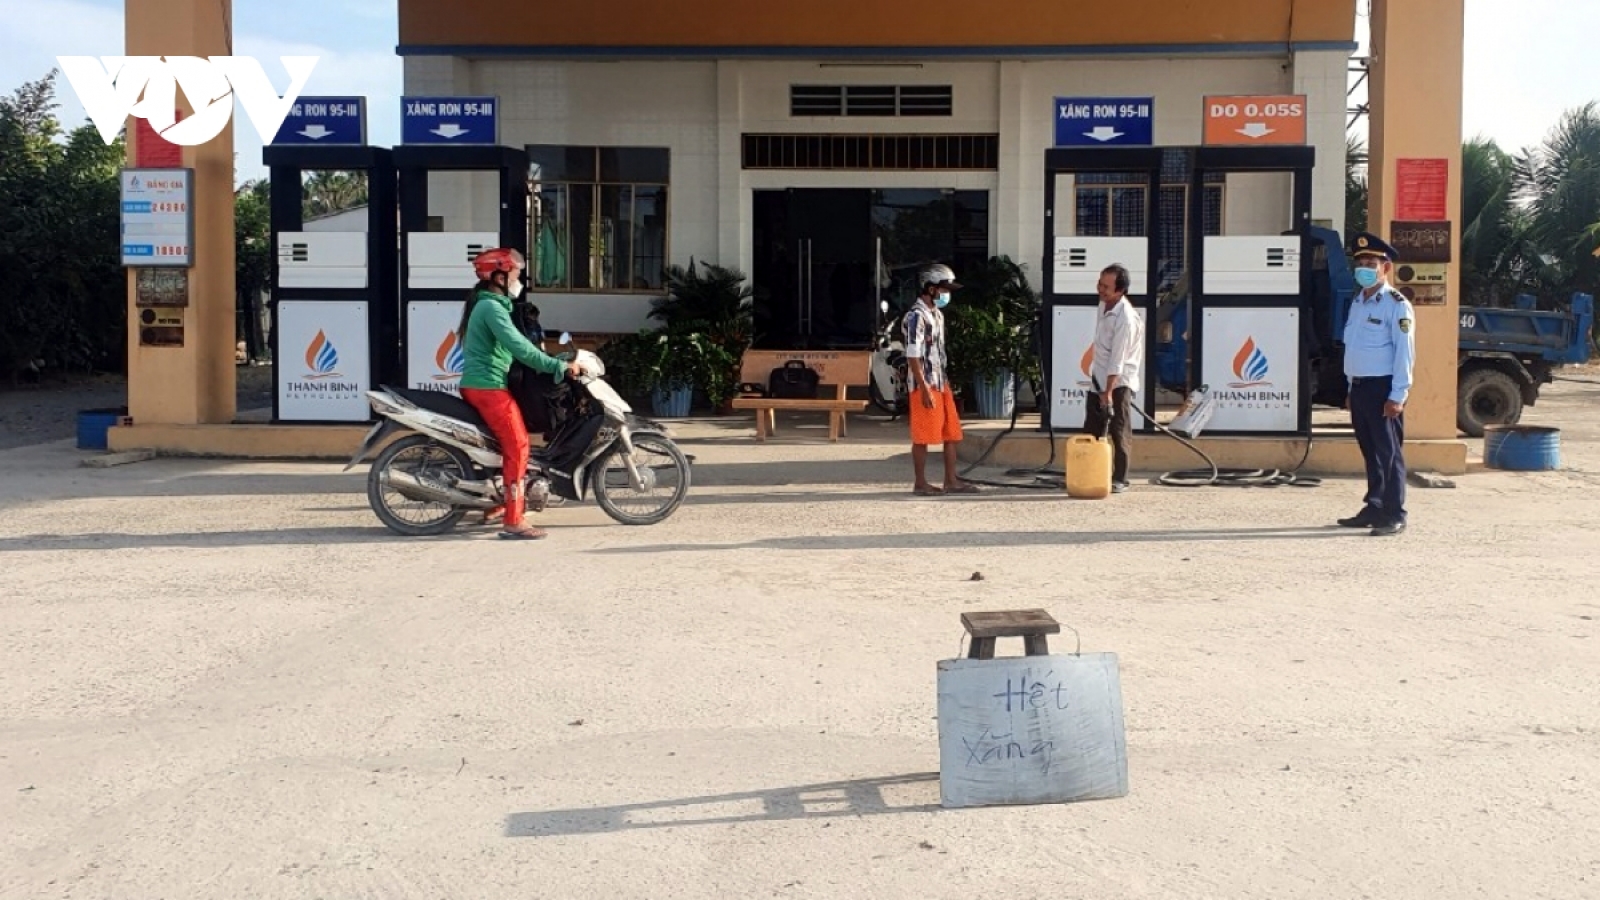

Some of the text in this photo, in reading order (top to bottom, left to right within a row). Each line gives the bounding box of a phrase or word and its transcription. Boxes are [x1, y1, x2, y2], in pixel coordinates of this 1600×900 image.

[305, 104, 327, 116] RON
[329, 104, 357, 116] 95-III
[439, 103, 461, 116] RON
[463, 103, 493, 116] 95-III
[1093, 104, 1117, 118] RON
[1120, 104, 1149, 118] 95-III
[1210, 103, 1302, 118] DO 0.05S
[287, 382, 358, 392] THANH BINH
[416, 382, 457, 392] THANH
[1213, 391, 1290, 401] THANH BINH
[993, 669, 1069, 712] Hết
